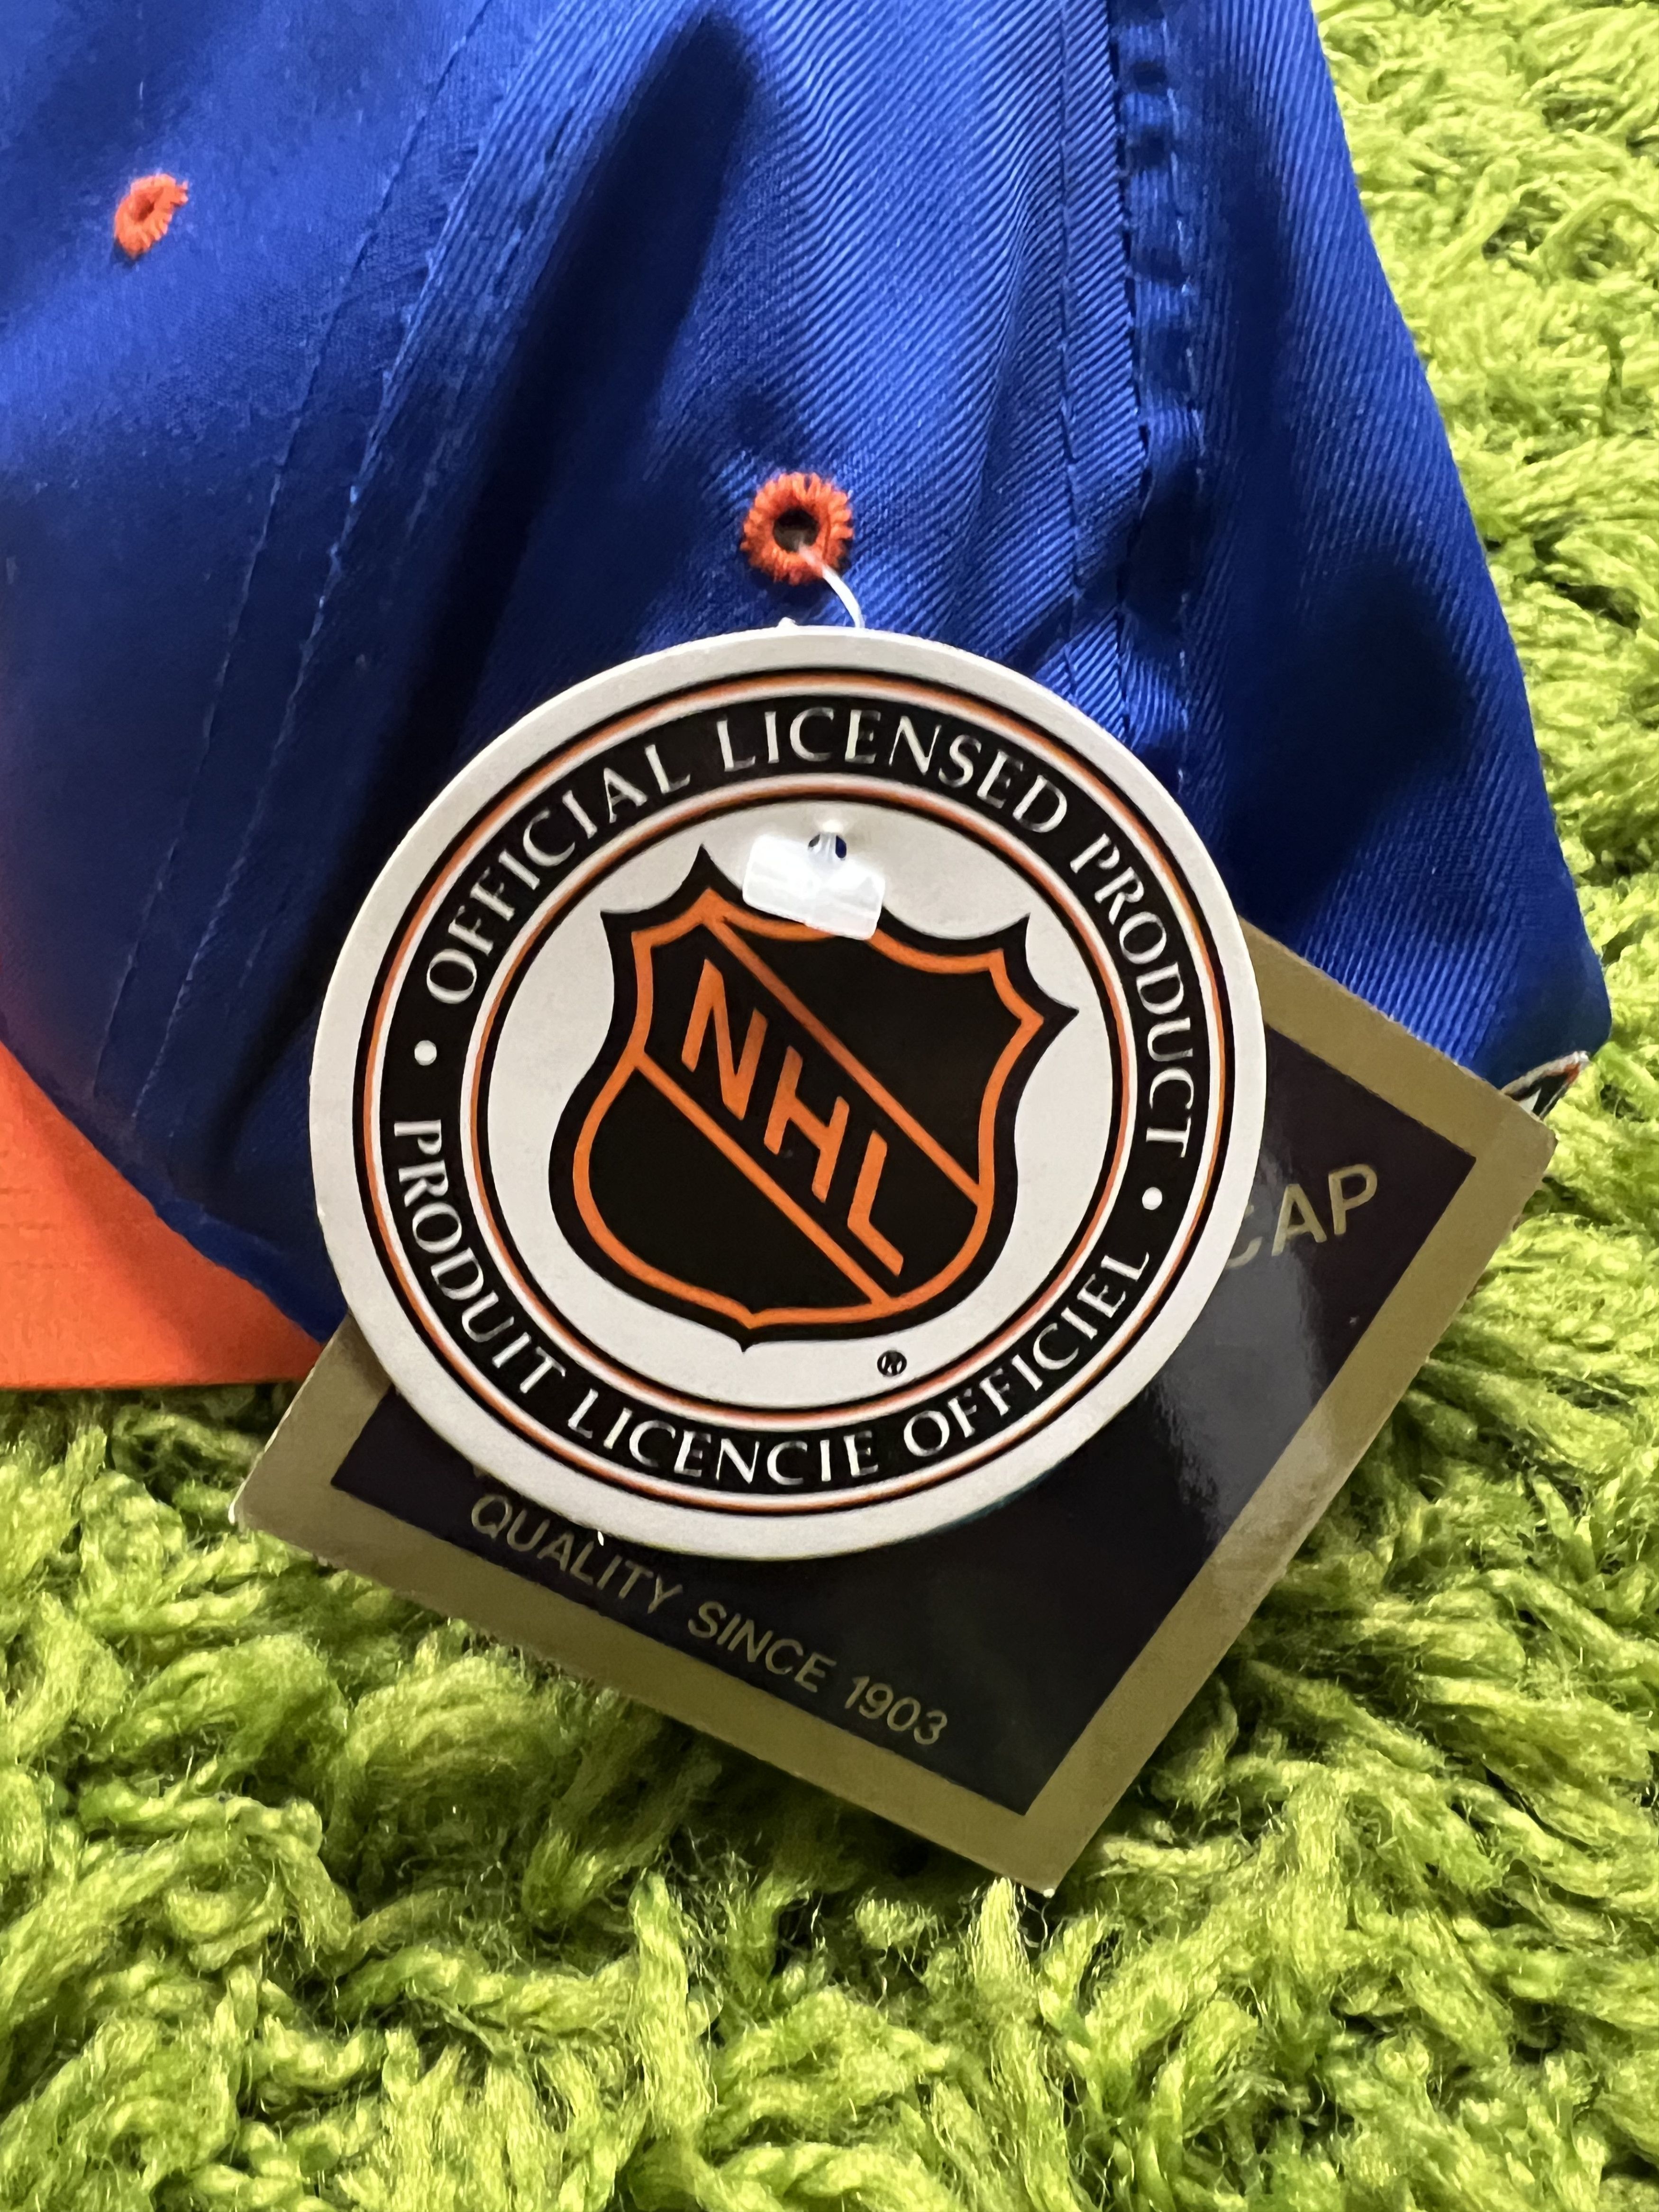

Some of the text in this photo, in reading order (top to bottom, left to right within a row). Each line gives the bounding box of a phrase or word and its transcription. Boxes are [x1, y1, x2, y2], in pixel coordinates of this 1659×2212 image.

[426, 707, 1194, 1157] OFFICIAL LICENSED PRODUCT
[681, 958, 903, 1277] NHL
[393, 1119, 1149, 1485] PRODUIT LICENCIE OFFICIEL
[471, 1494, 948, 1746] QUALITY SINCE 1903
